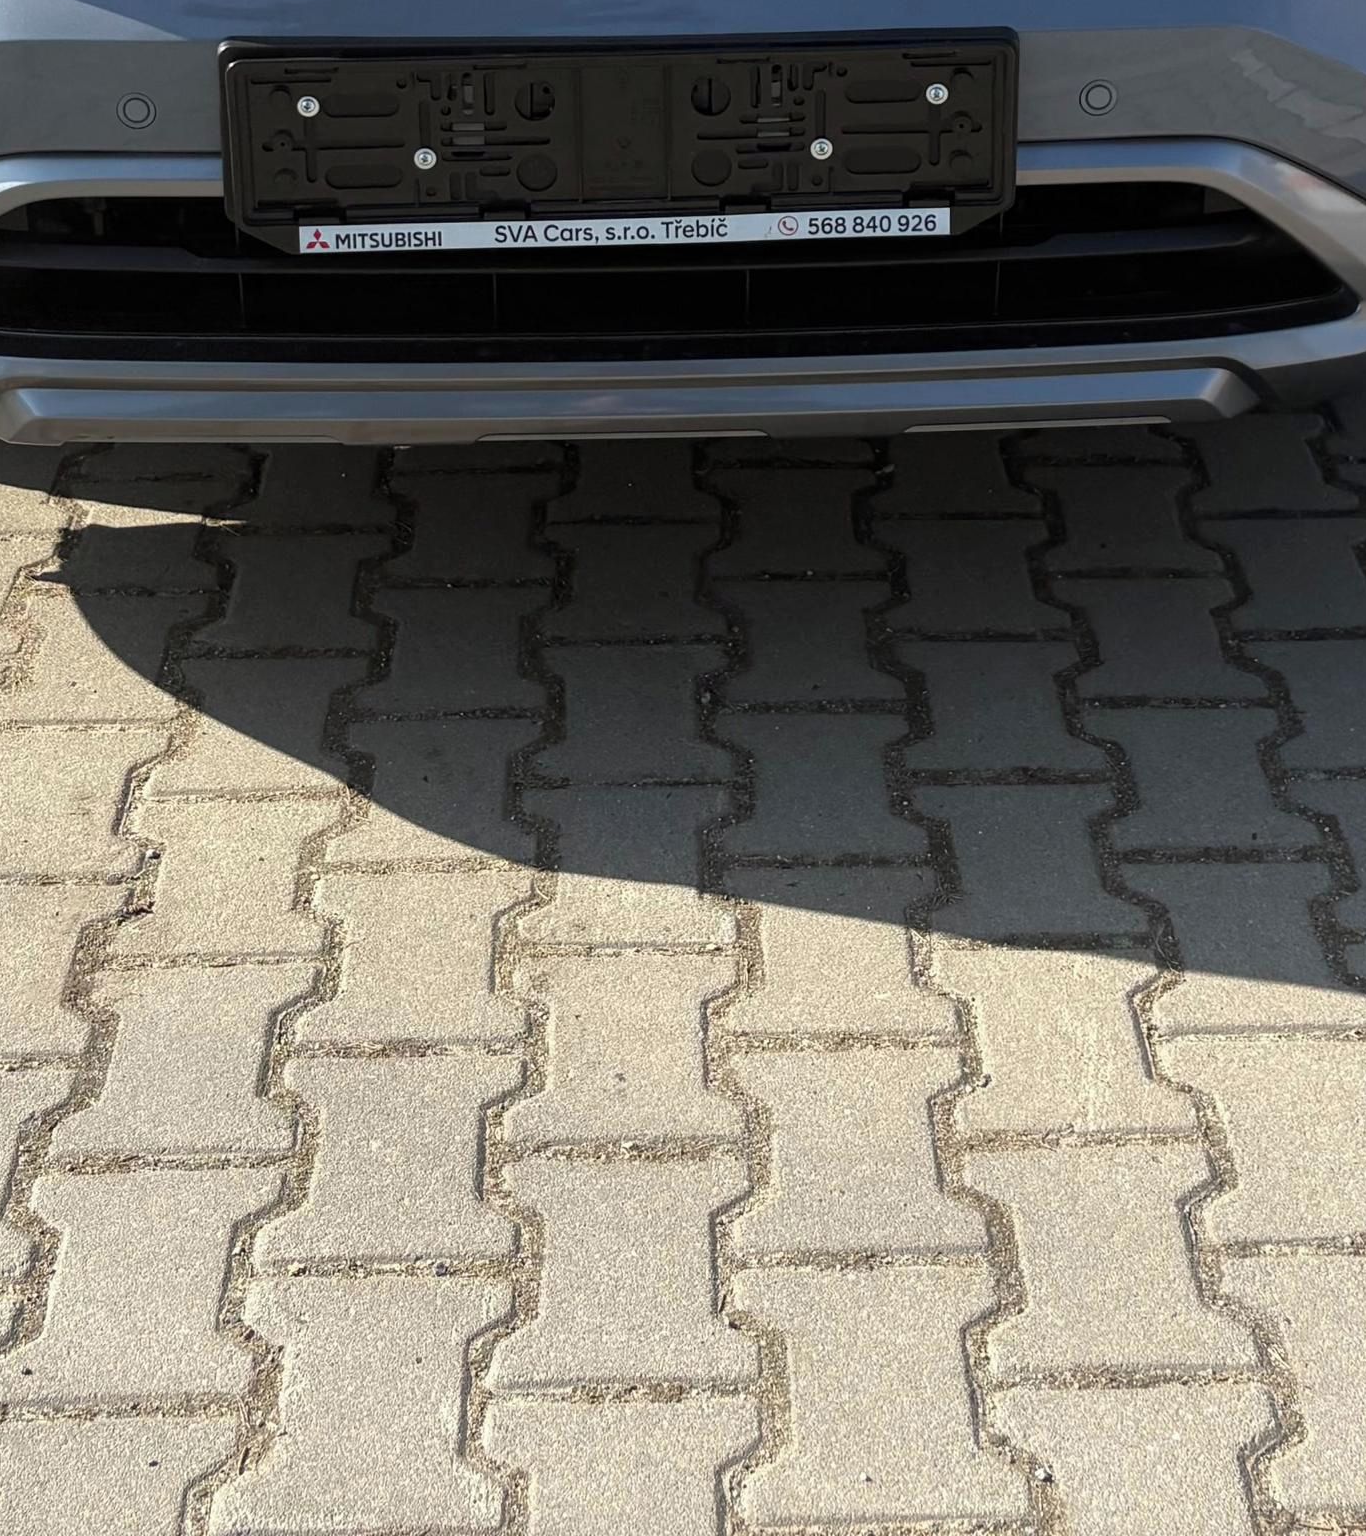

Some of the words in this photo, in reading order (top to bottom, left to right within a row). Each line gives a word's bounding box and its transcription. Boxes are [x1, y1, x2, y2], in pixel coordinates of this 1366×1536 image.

[335, 230, 443, 250] MITSUBISHI
[494, 224, 537, 243] SVA
[542, 223, 599, 244] Cars,
[604, 221, 656, 241] s.r.o.
[661, 218, 729, 239] Třebíč
[807, 216, 847, 235] 568
[851, 215, 892, 234] 840
[897, 213, 937, 233] 926
